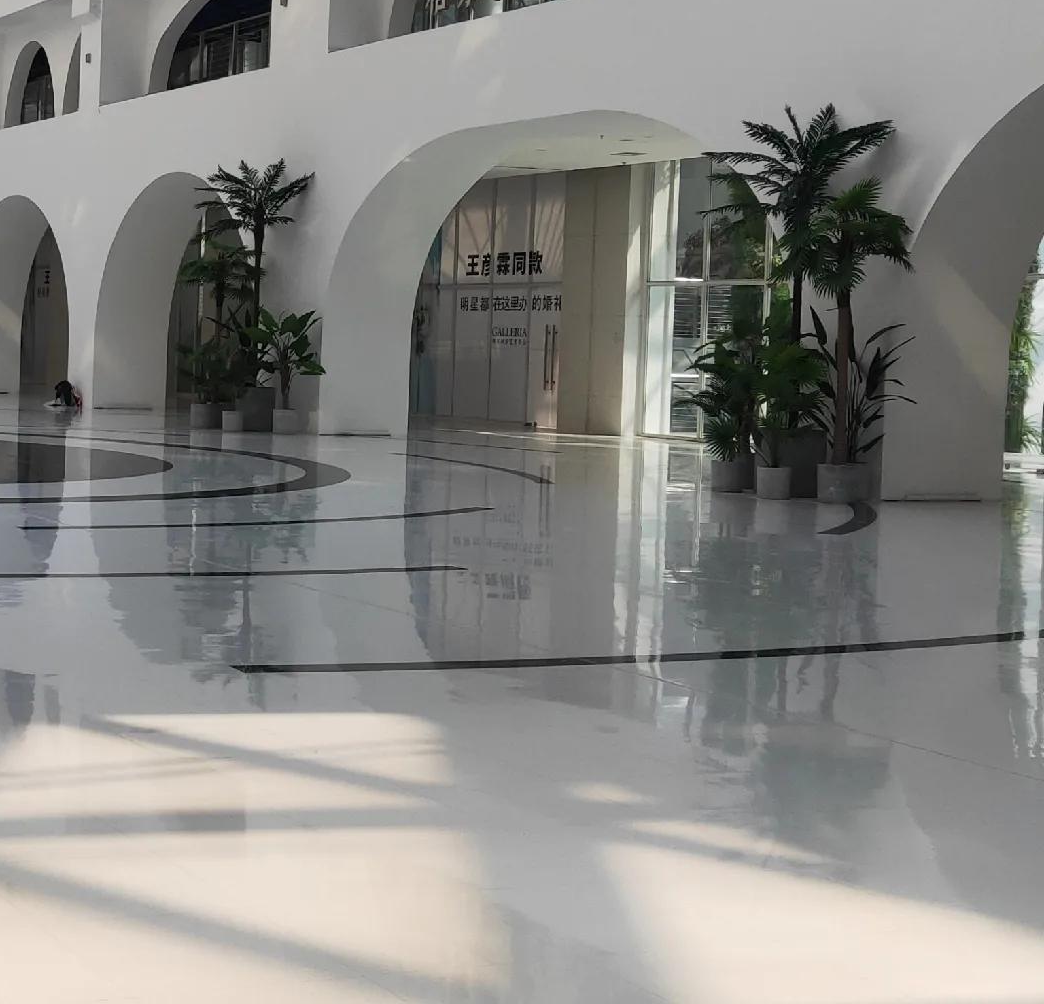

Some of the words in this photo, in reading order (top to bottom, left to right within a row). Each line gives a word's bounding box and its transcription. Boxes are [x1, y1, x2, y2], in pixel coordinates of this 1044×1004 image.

[466, 250, 543, 276] 王彦霖同款
